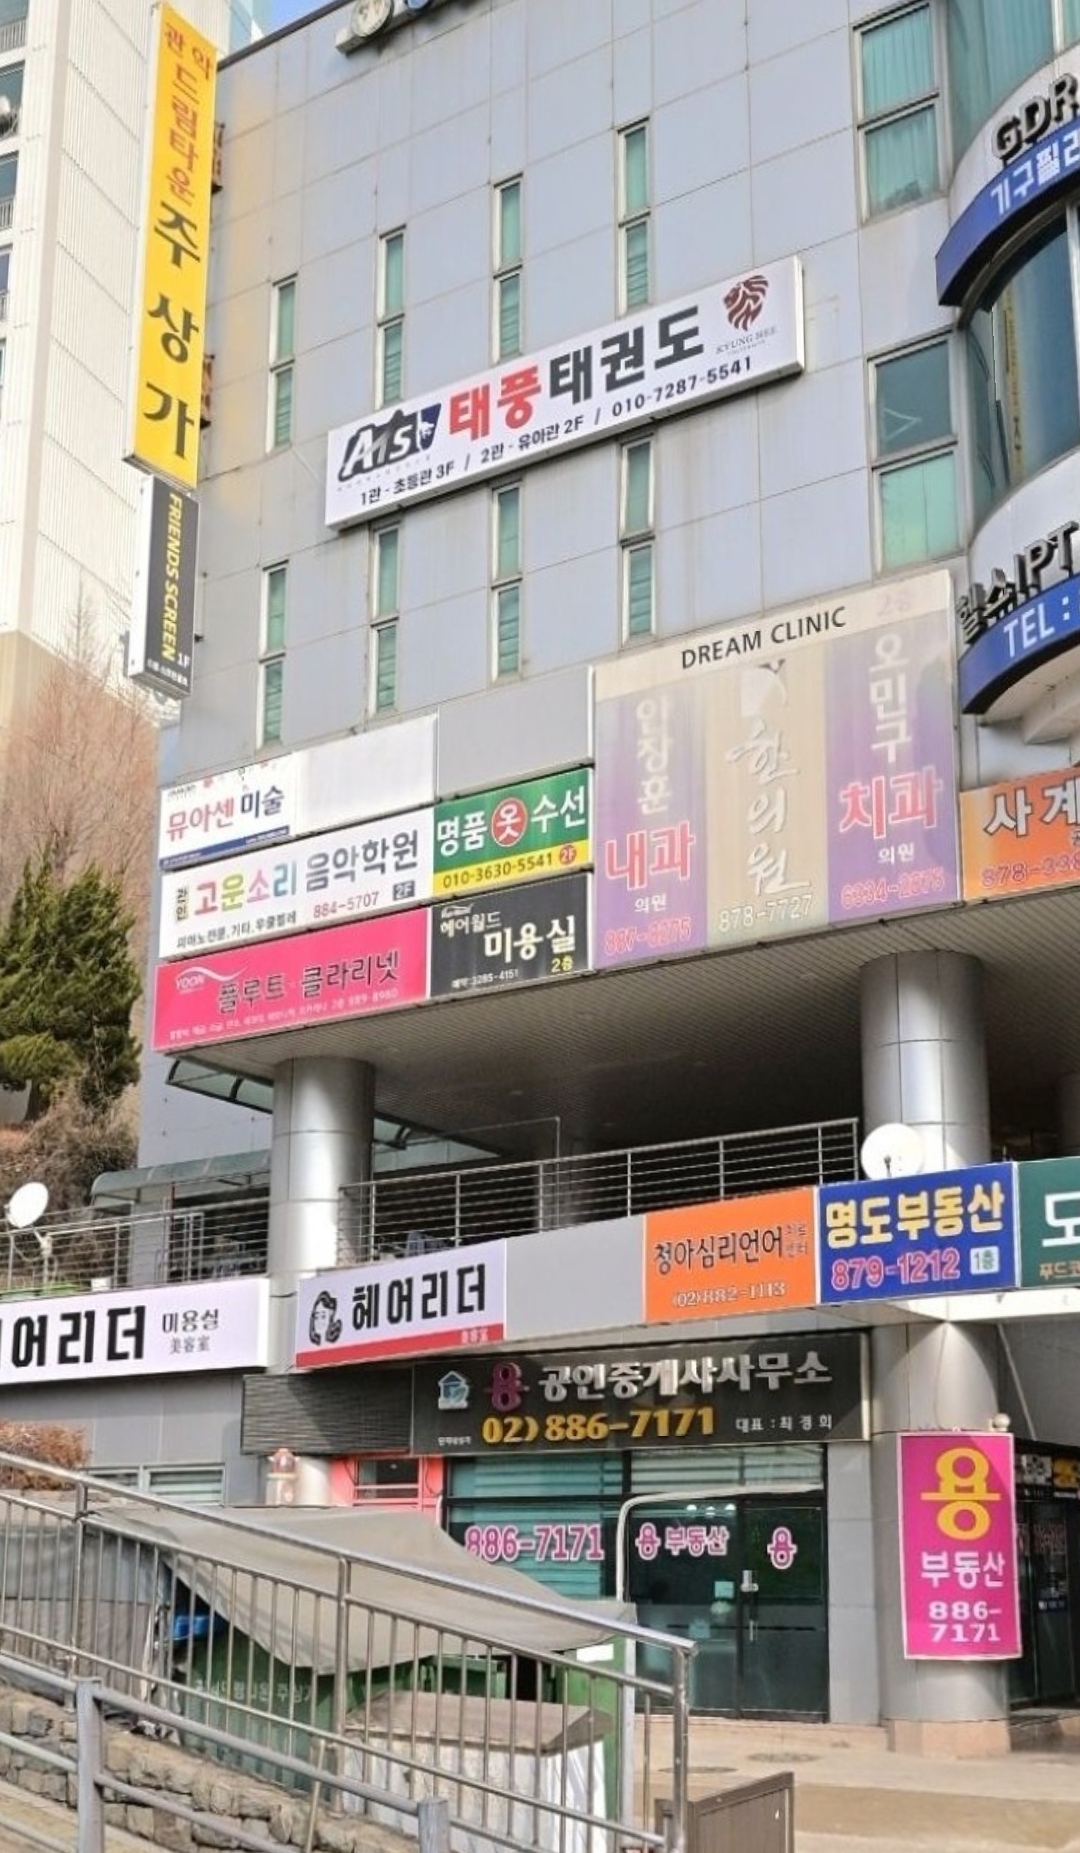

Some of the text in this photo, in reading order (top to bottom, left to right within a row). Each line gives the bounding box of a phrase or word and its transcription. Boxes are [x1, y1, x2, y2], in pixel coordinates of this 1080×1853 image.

[165, 22, 212, 80] 관악
[393, 470, 432, 494] 초등관
[436, 461, 454, 479] 3F
[481, 444, 504, 463] 2관
[517, 424, 559, 451] 유아관
[564, 415, 584, 434] 2F
[612, 356, 751, 417] 010-7287-5541
[166, 492, 182, 580] FRIENDS
[161, 581, 179, 661] SCREEN
[682, 606, 847, 669] DREAM CLINIC
[1003, 602, 1055, 658] TEL
[869, 633, 912, 764] 오민구
[241, 785, 285, 818] 미술
[437, 785, 586, 857] 명품 옷 수선
[724, 712, 811, 895] 한의원
[839, 766, 944, 840] 치과
[195, 829, 419, 916] 고운소리 음악학원
[443, 853, 553, 889] 010-3630-5541
[605, 820, 696, 891] 내과
[878, 842, 915, 865] 의원
[313, 891, 380, 918] 884-5707
[634, 893, 667, 913] 의원
[718, 894, 814, 932] 878-7727
[484, 915, 576, 964] 미용실
[302, 951, 399, 999] 클라리넷
[825, 1180, 1004, 1249] 명도부동산
[654, 1226, 783, 1276] 청아심리언어
[831, 1247, 960, 1291] 879-1212
[162, 1308, 219, 1333] 미용실
[352, 1263, 486, 1331] 헤어리더
[0, 1306, 146, 1370] 어리더
[485, 1351, 832, 1412] 용 공인중개사사무소
[544, 1407, 714, 1441] 886-7171
[920, 1446, 1001, 1541] 용
[465, 1522, 605, 1562] 886-7171
[635, 1522, 730, 1560] 용 부동산
[767, 1526, 798, 1569] 용
[920, 1551, 1006, 1589] 부동산
[928, 1600, 1002, 1621] 886-
[929, 1623, 1001, 1642] 7171
